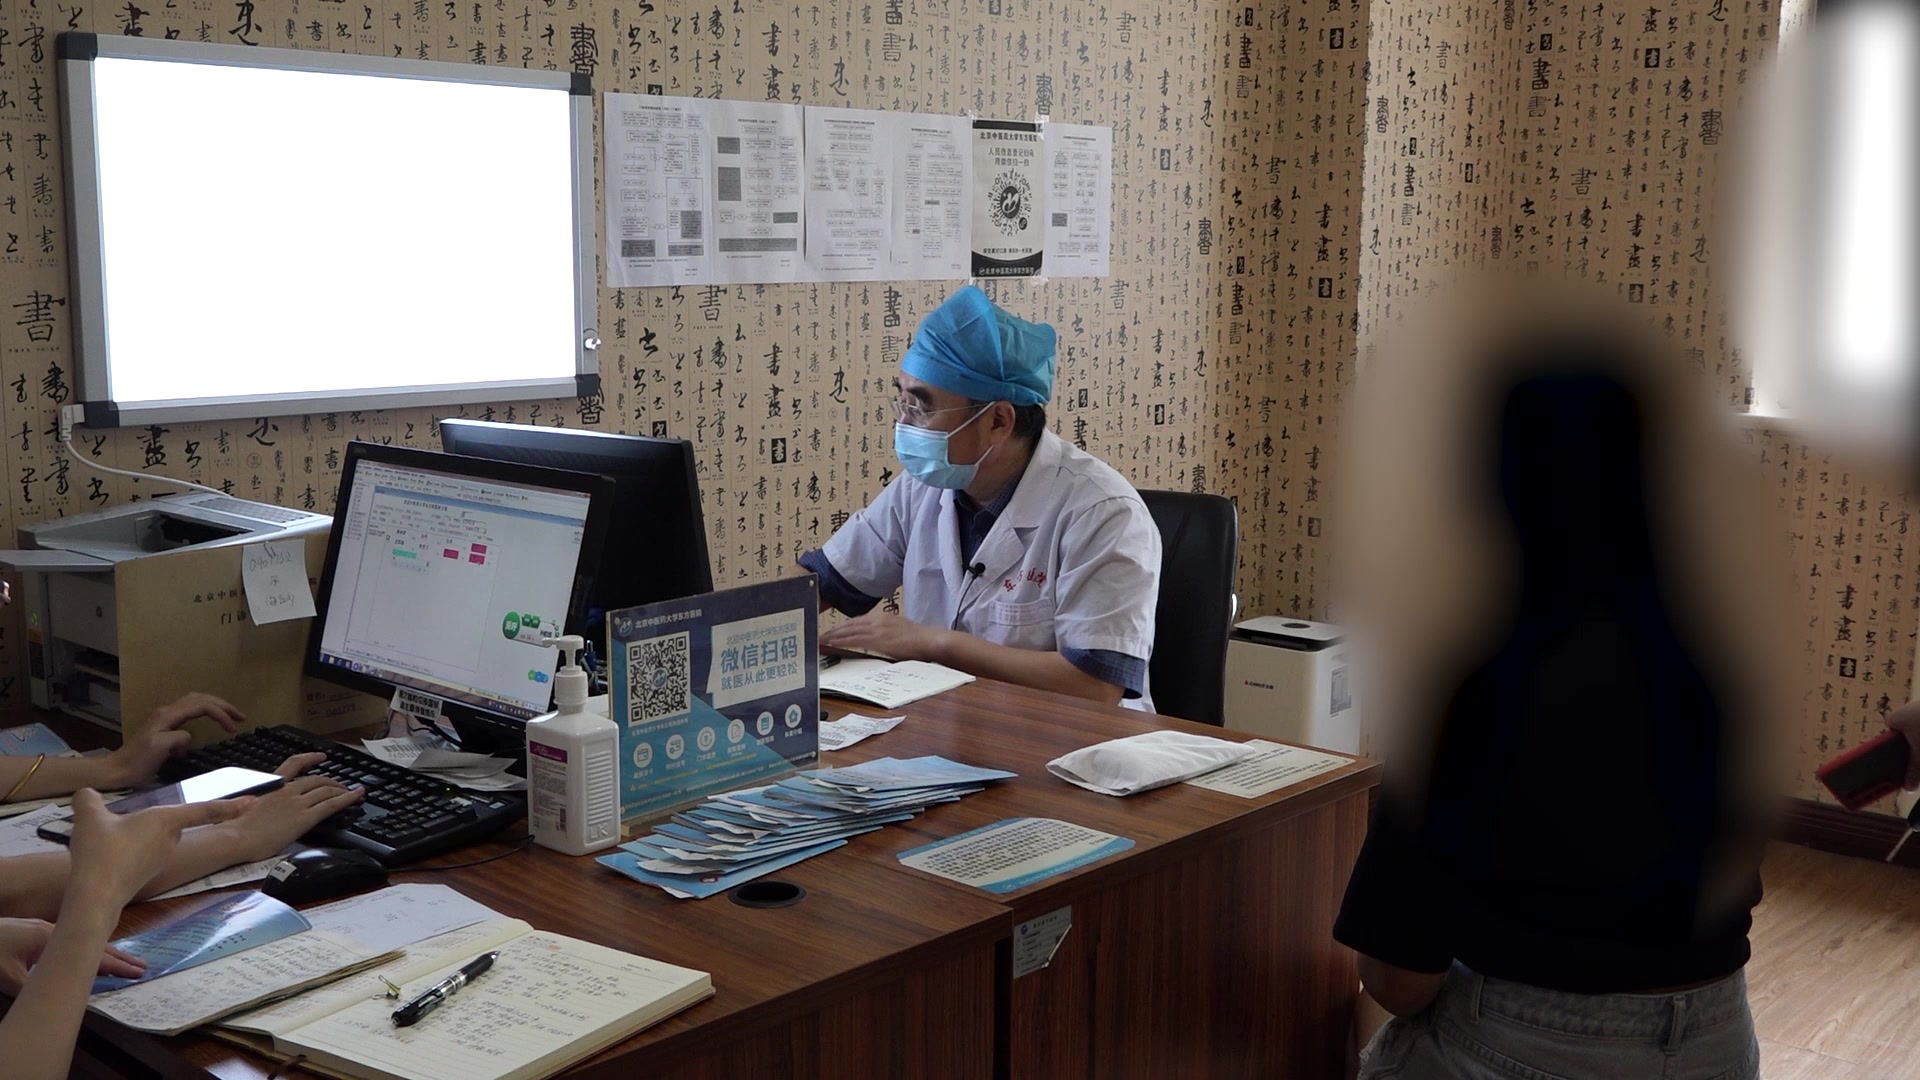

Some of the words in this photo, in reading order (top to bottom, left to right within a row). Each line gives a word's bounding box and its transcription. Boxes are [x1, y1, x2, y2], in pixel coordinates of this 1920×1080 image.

[720, 636, 797, 671] 微信扫码
[720, 662, 798, 689] 就医从此更轻松
